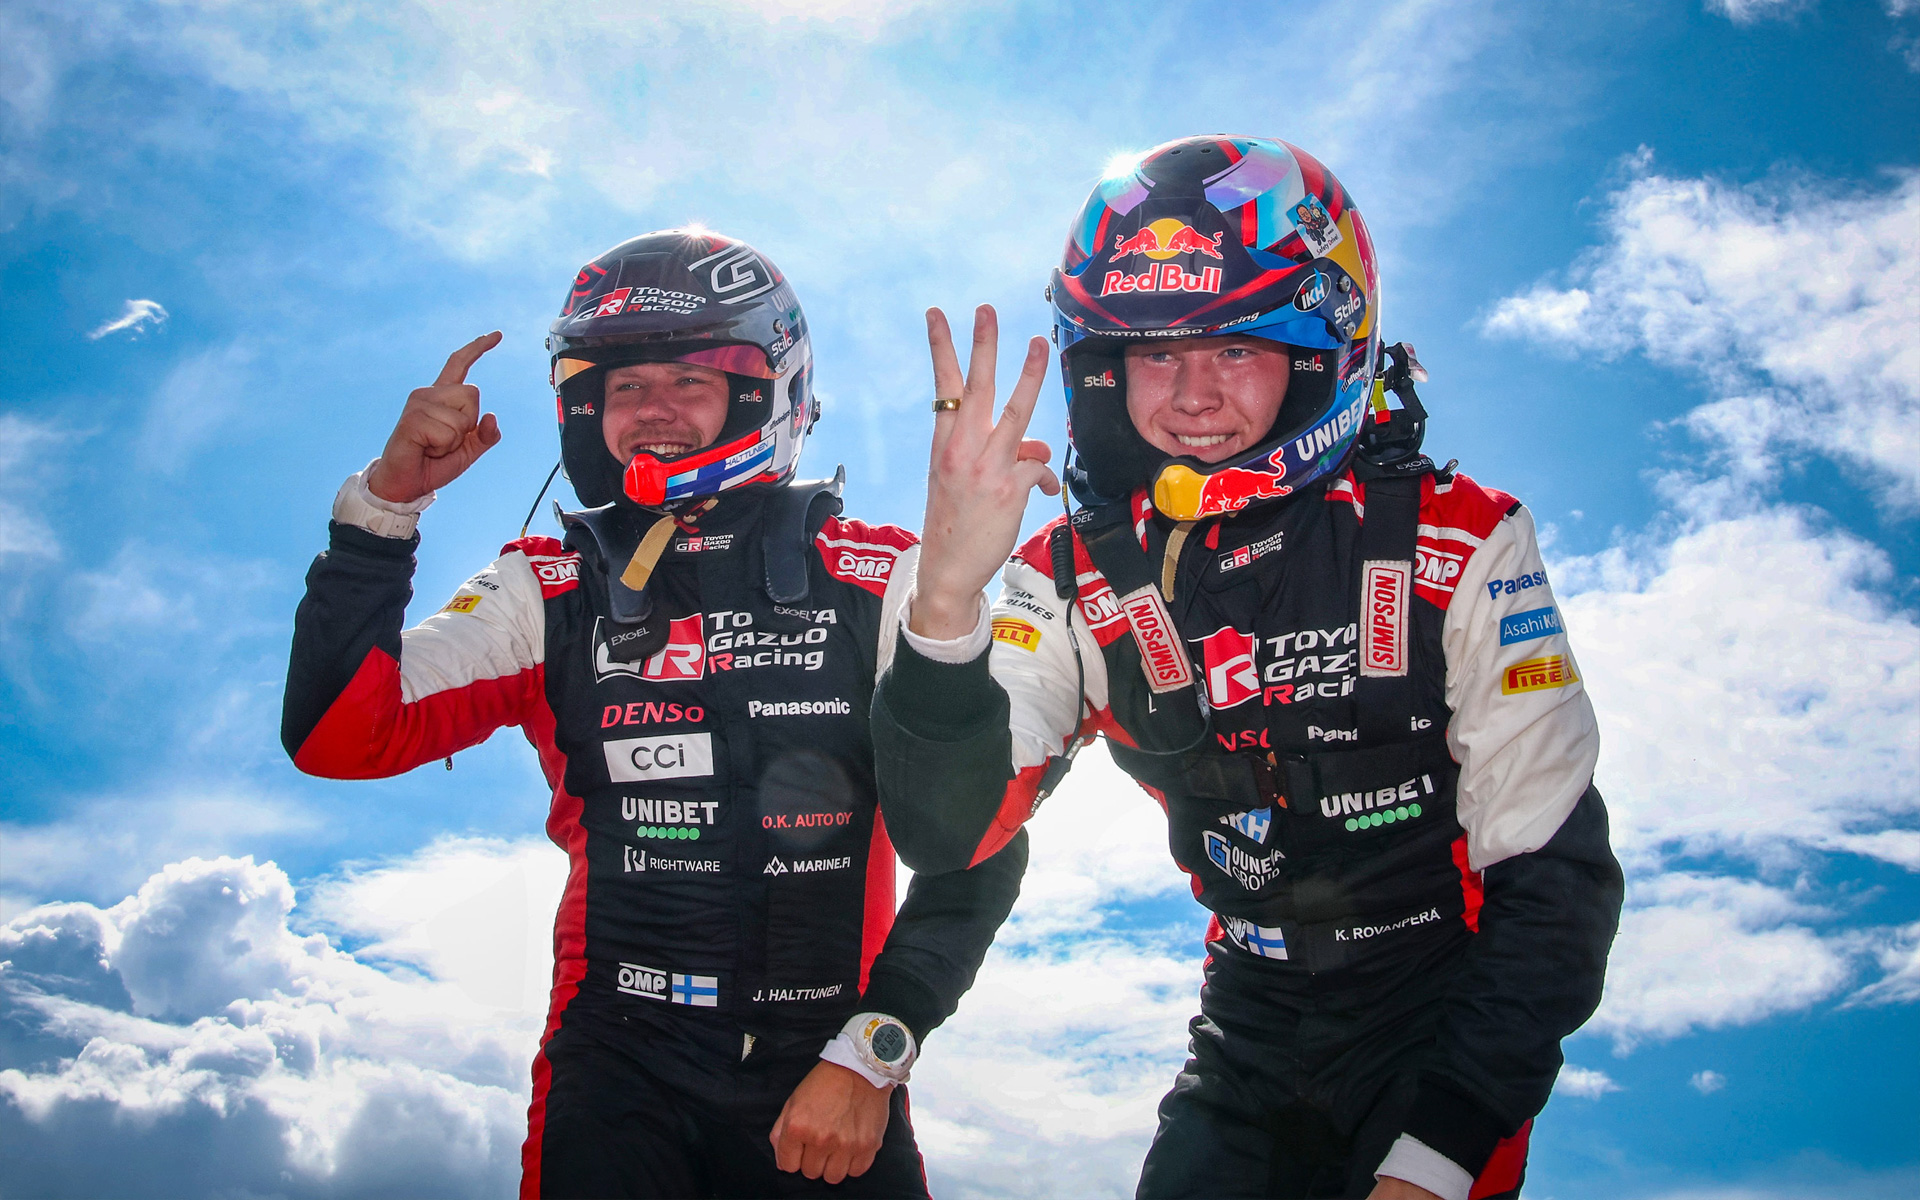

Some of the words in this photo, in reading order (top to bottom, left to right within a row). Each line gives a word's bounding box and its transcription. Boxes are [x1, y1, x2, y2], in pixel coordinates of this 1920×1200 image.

[1100, 263, 1158, 296] Red
[1158, 263, 1222, 294] Bull
[630, 295, 698, 309] GAZOO
[636, 286, 707, 304] TOYOTA
[626, 303, 692, 315] Racing
[1334, 294, 1361, 324] Stilo
[1144, 327, 1203, 337] GAZOO
[1206, 311, 1260, 333] Racing
[771, 333, 794, 357] Stilo
[1294, 356, 1324, 372] Stilo
[1084, 371, 1116, 388] Stilo
[739, 390, 763, 403] Stilo
[570, 403, 595, 416] Stilo
[726, 441, 768, 466] HALTTUNEN
[676, 542, 701, 551] GR
[704, 534, 734, 542] TOYOTA
[1250, 531, 1284, 549] TOYOTA
[1252, 538, 1282, 555] GAZOO
[1252, 544, 1282, 560] Racing
[838, 555, 891, 577] OMP
[1220, 553, 1249, 570] GR
[538, 563, 579, 581] OM
[774, 604, 812, 622] EXGEL
[1083, 594, 1124, 622] OM
[1372, 574, 1396, 666] SIMPSON
[611, 627, 650, 646] EXGEL
[1130, 602, 1180, 681] SIMPSON
[1266, 623, 1357, 658] TOYO
[708, 648, 824, 674] Racing
[1264, 649, 1357, 683] GAZ
[1263, 674, 1357, 706] Raci
[601, 702, 705, 728] DENSO
[748, 697, 851, 718] Panasonic
[621, 796, 719, 825] UNIBET
[762, 814, 792, 829] O.K.
[795, 812, 834, 828] AUTO
[836, 811, 853, 826] OY
[650, 857, 721, 873] RIGHTWARE
[793, 856, 851, 873] MARINE.FI
[1335, 929, 1350, 941] K.
[1353, 907, 1441, 940] ROVANPERÄ
[617, 968, 667, 994] OMP
[752, 989, 765, 1002] J.
[768, 984, 842, 1002] HALTTUNEN
